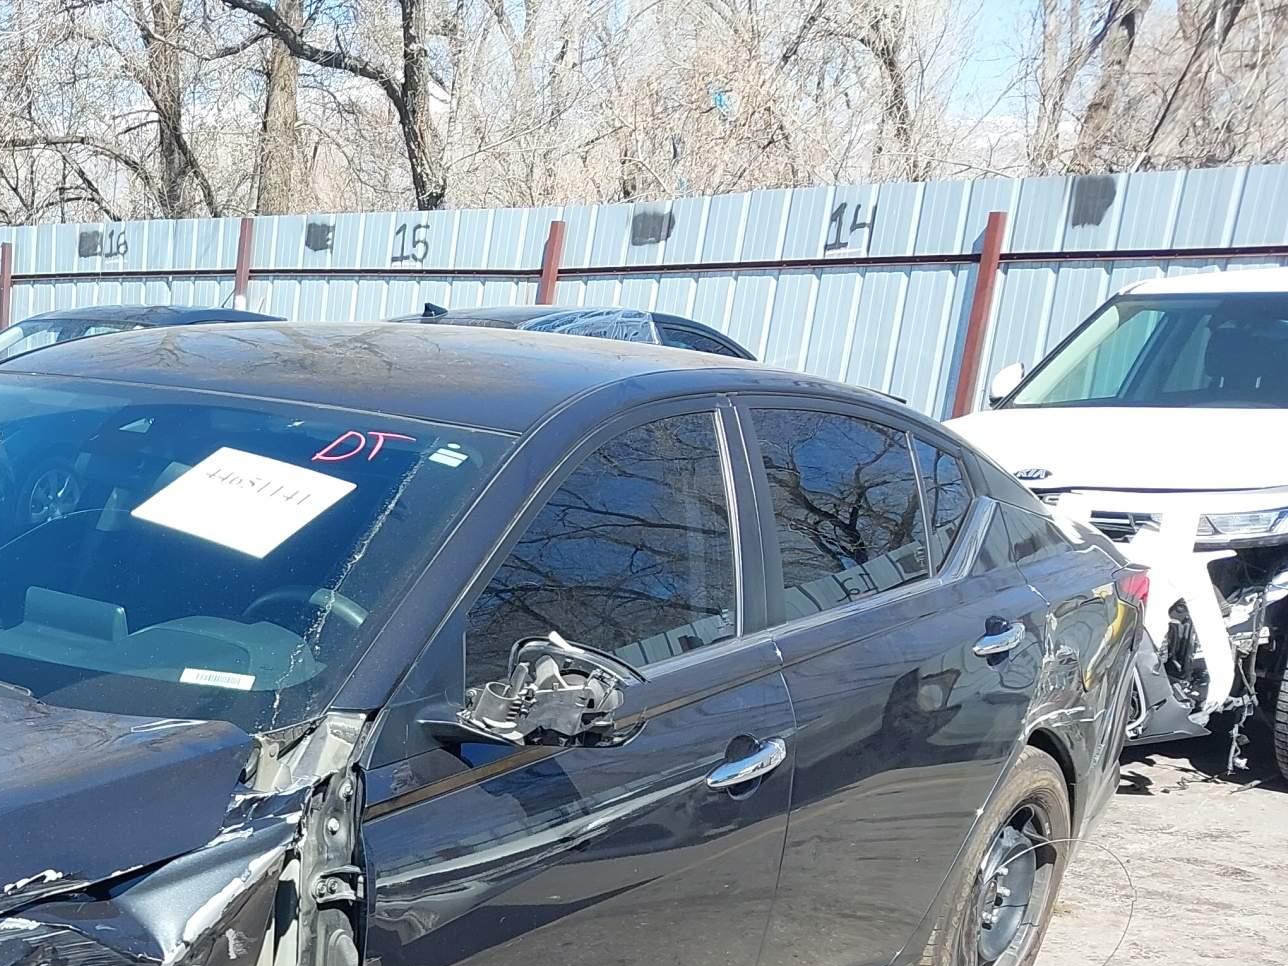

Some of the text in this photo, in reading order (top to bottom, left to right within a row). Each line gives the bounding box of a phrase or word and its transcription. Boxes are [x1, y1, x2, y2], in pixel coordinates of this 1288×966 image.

[105, 229, 128, 258] 16
[392, 223, 431, 263] 15
[824, 202, 878, 253] 14
[311, 430, 417, 462] DT
